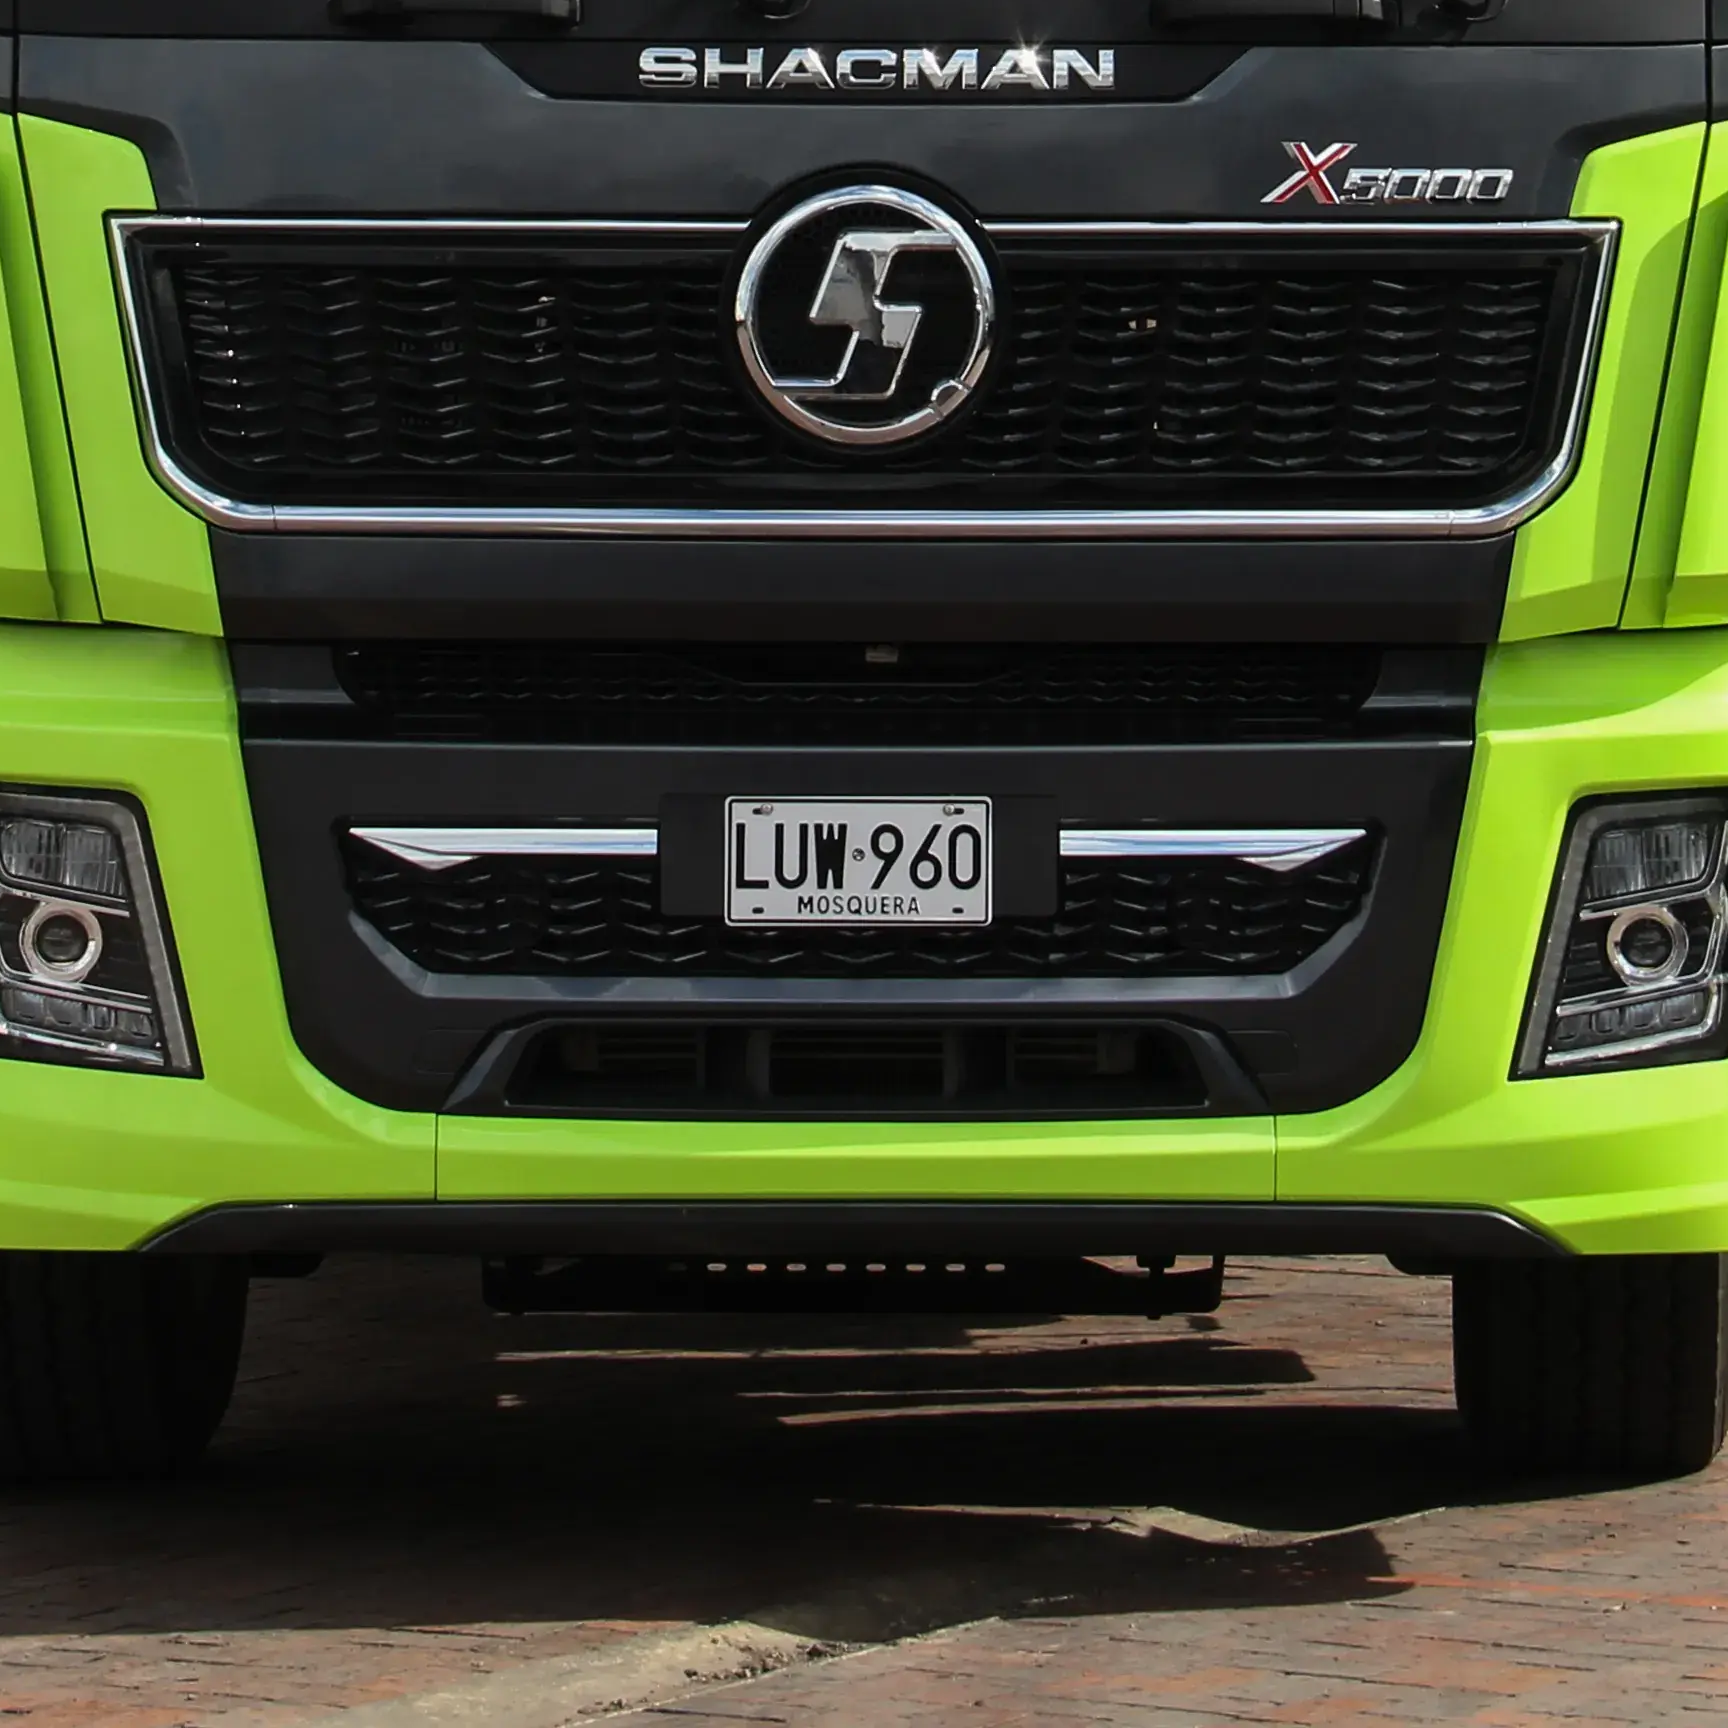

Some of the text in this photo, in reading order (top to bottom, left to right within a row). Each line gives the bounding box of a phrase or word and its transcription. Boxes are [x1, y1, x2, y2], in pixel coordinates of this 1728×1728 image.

[638, 47, 1114, 89] SHACMAN
[1260, 141, 1514, 205] X5000
[797, 896, 920, 915] MOSQUERA
